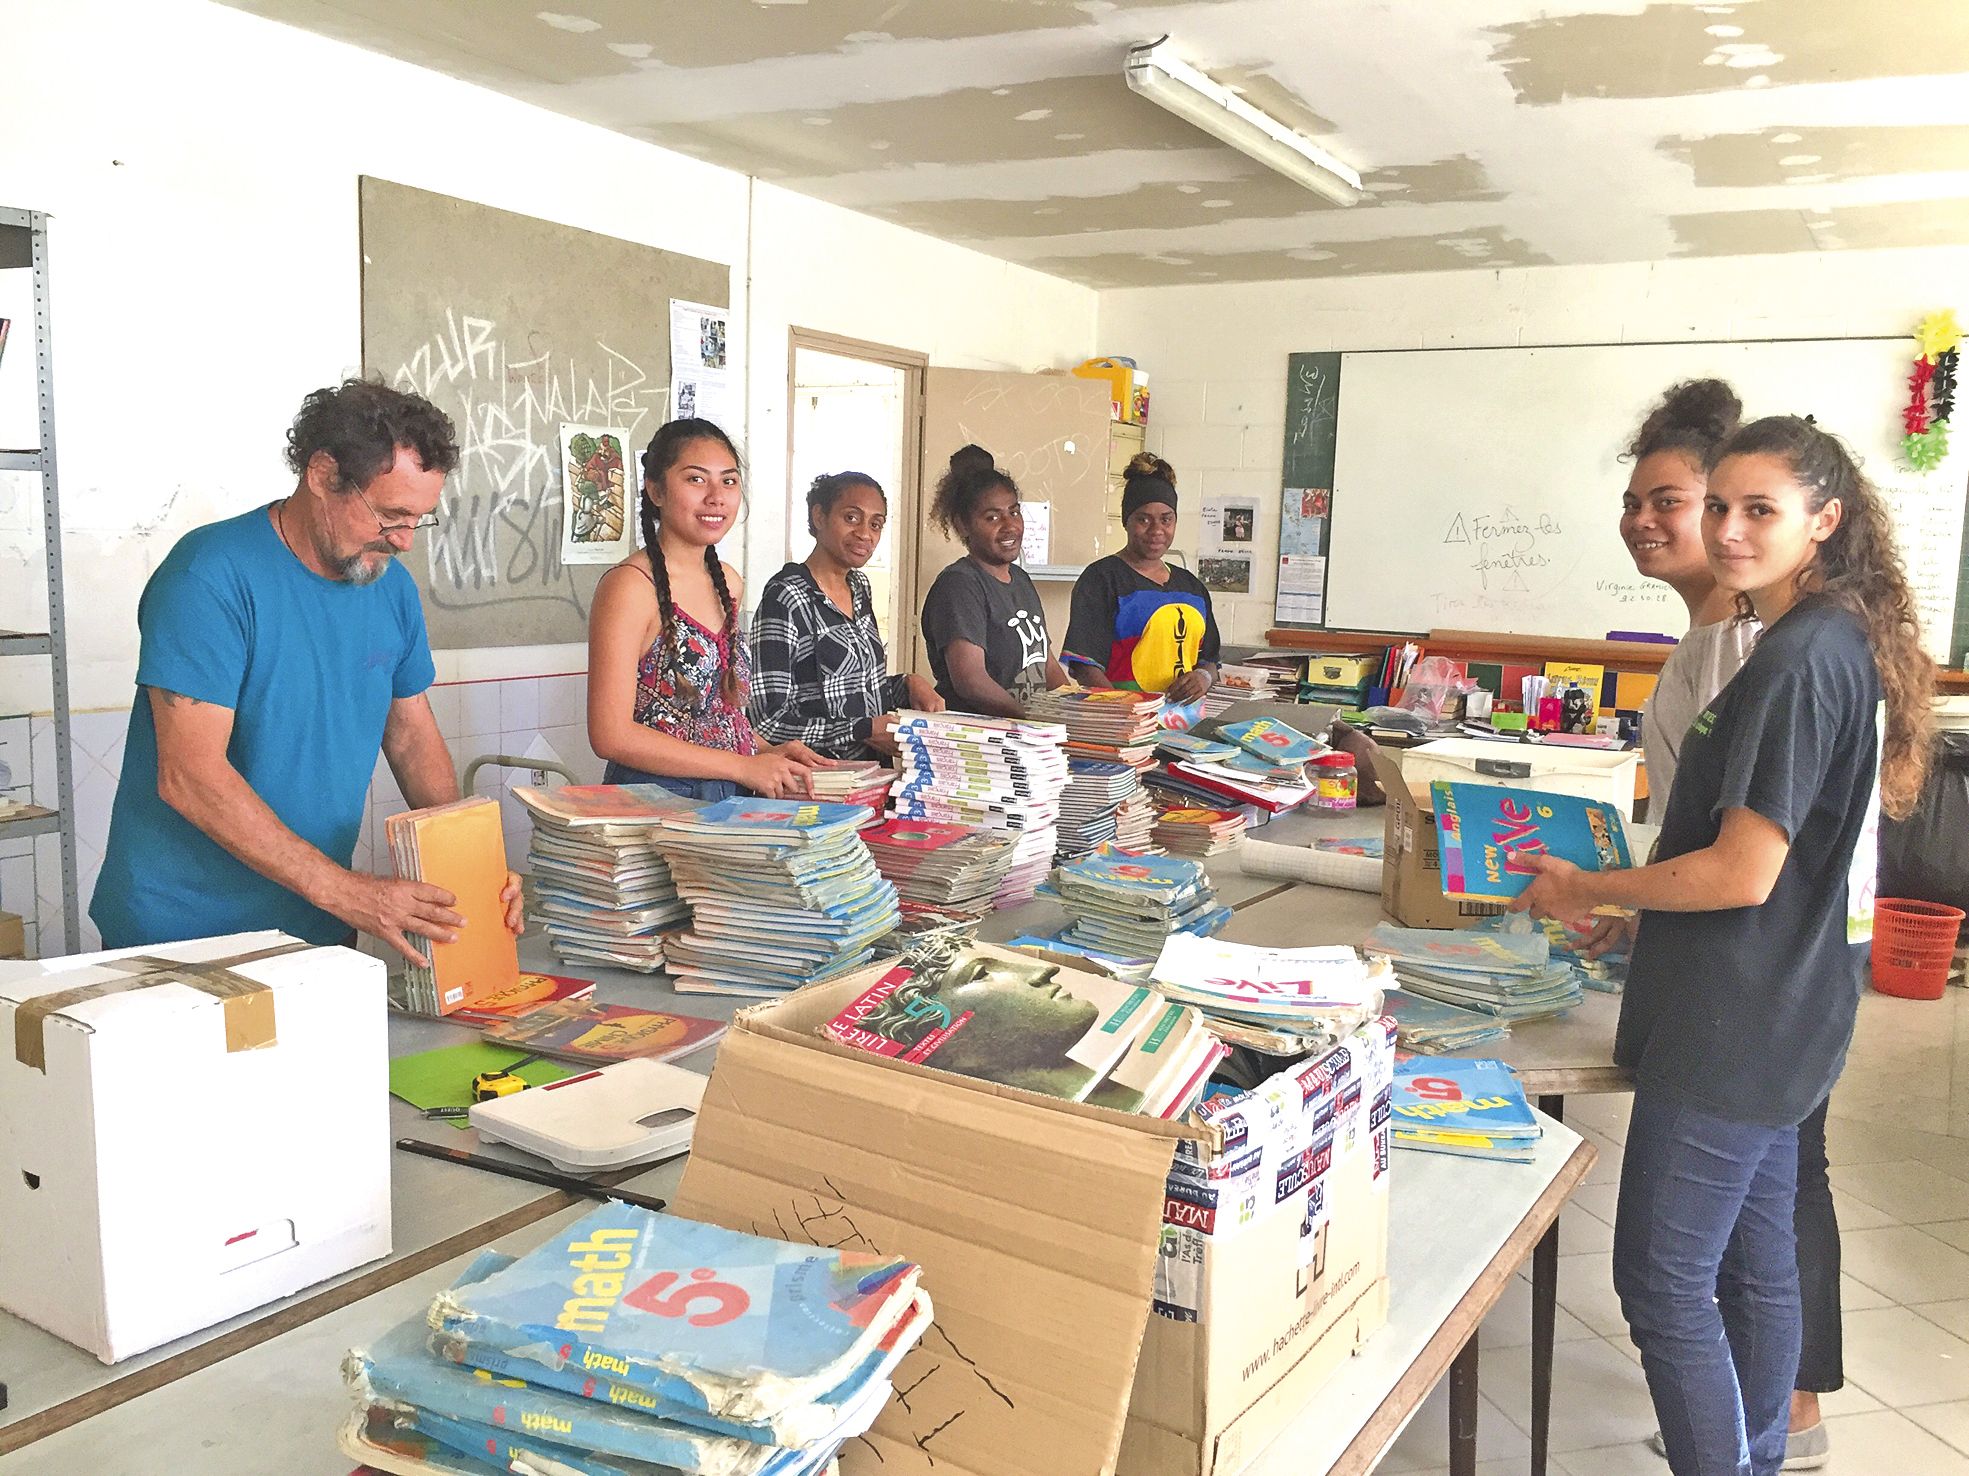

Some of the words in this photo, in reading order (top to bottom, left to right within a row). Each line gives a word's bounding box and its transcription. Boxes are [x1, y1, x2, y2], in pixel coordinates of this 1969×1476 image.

[1241, 719, 1274, 743] math
[1447, 790, 1462, 842] anglais
[845, 981, 897, 1021] LATIN
[847, 1027, 889, 1051] LIRE
[1395, 1096, 1512, 1120] math
[555, 1228, 639, 1333] math
[583, 1347, 630, 1377] math
[609, 1385, 657, 1409] math
[521, 1411, 573, 1434] math
